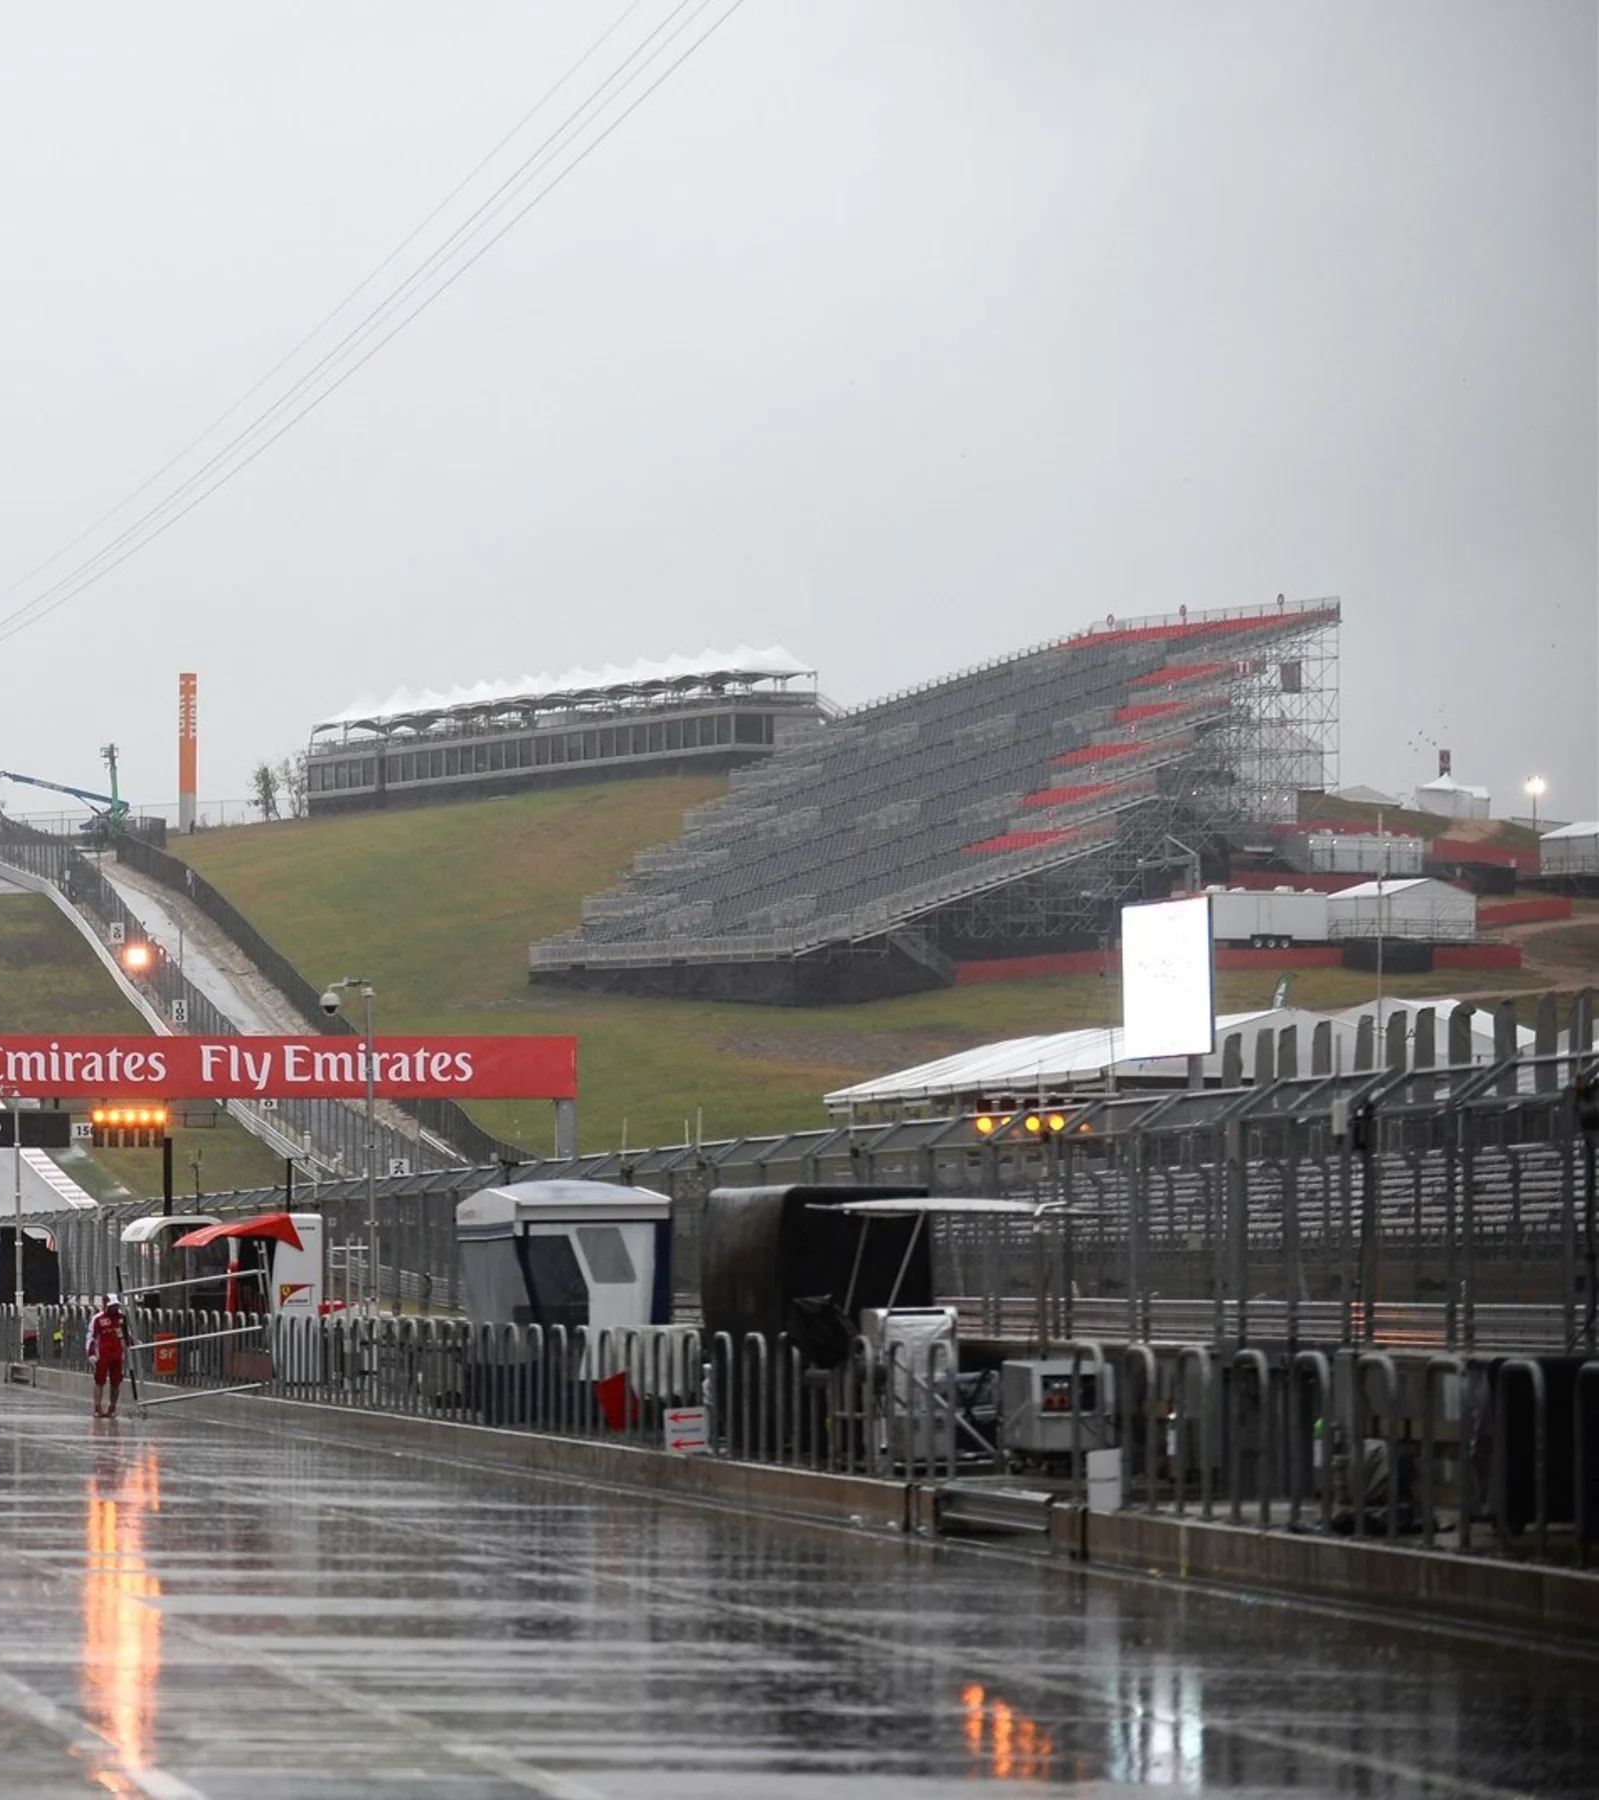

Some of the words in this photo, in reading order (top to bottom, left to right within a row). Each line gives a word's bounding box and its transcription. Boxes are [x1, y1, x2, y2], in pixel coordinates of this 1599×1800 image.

[200, 1044, 272, 1090] Fly
[283, 1043, 473, 1082] Emirates
[77, 1126, 93, 1136] 15
